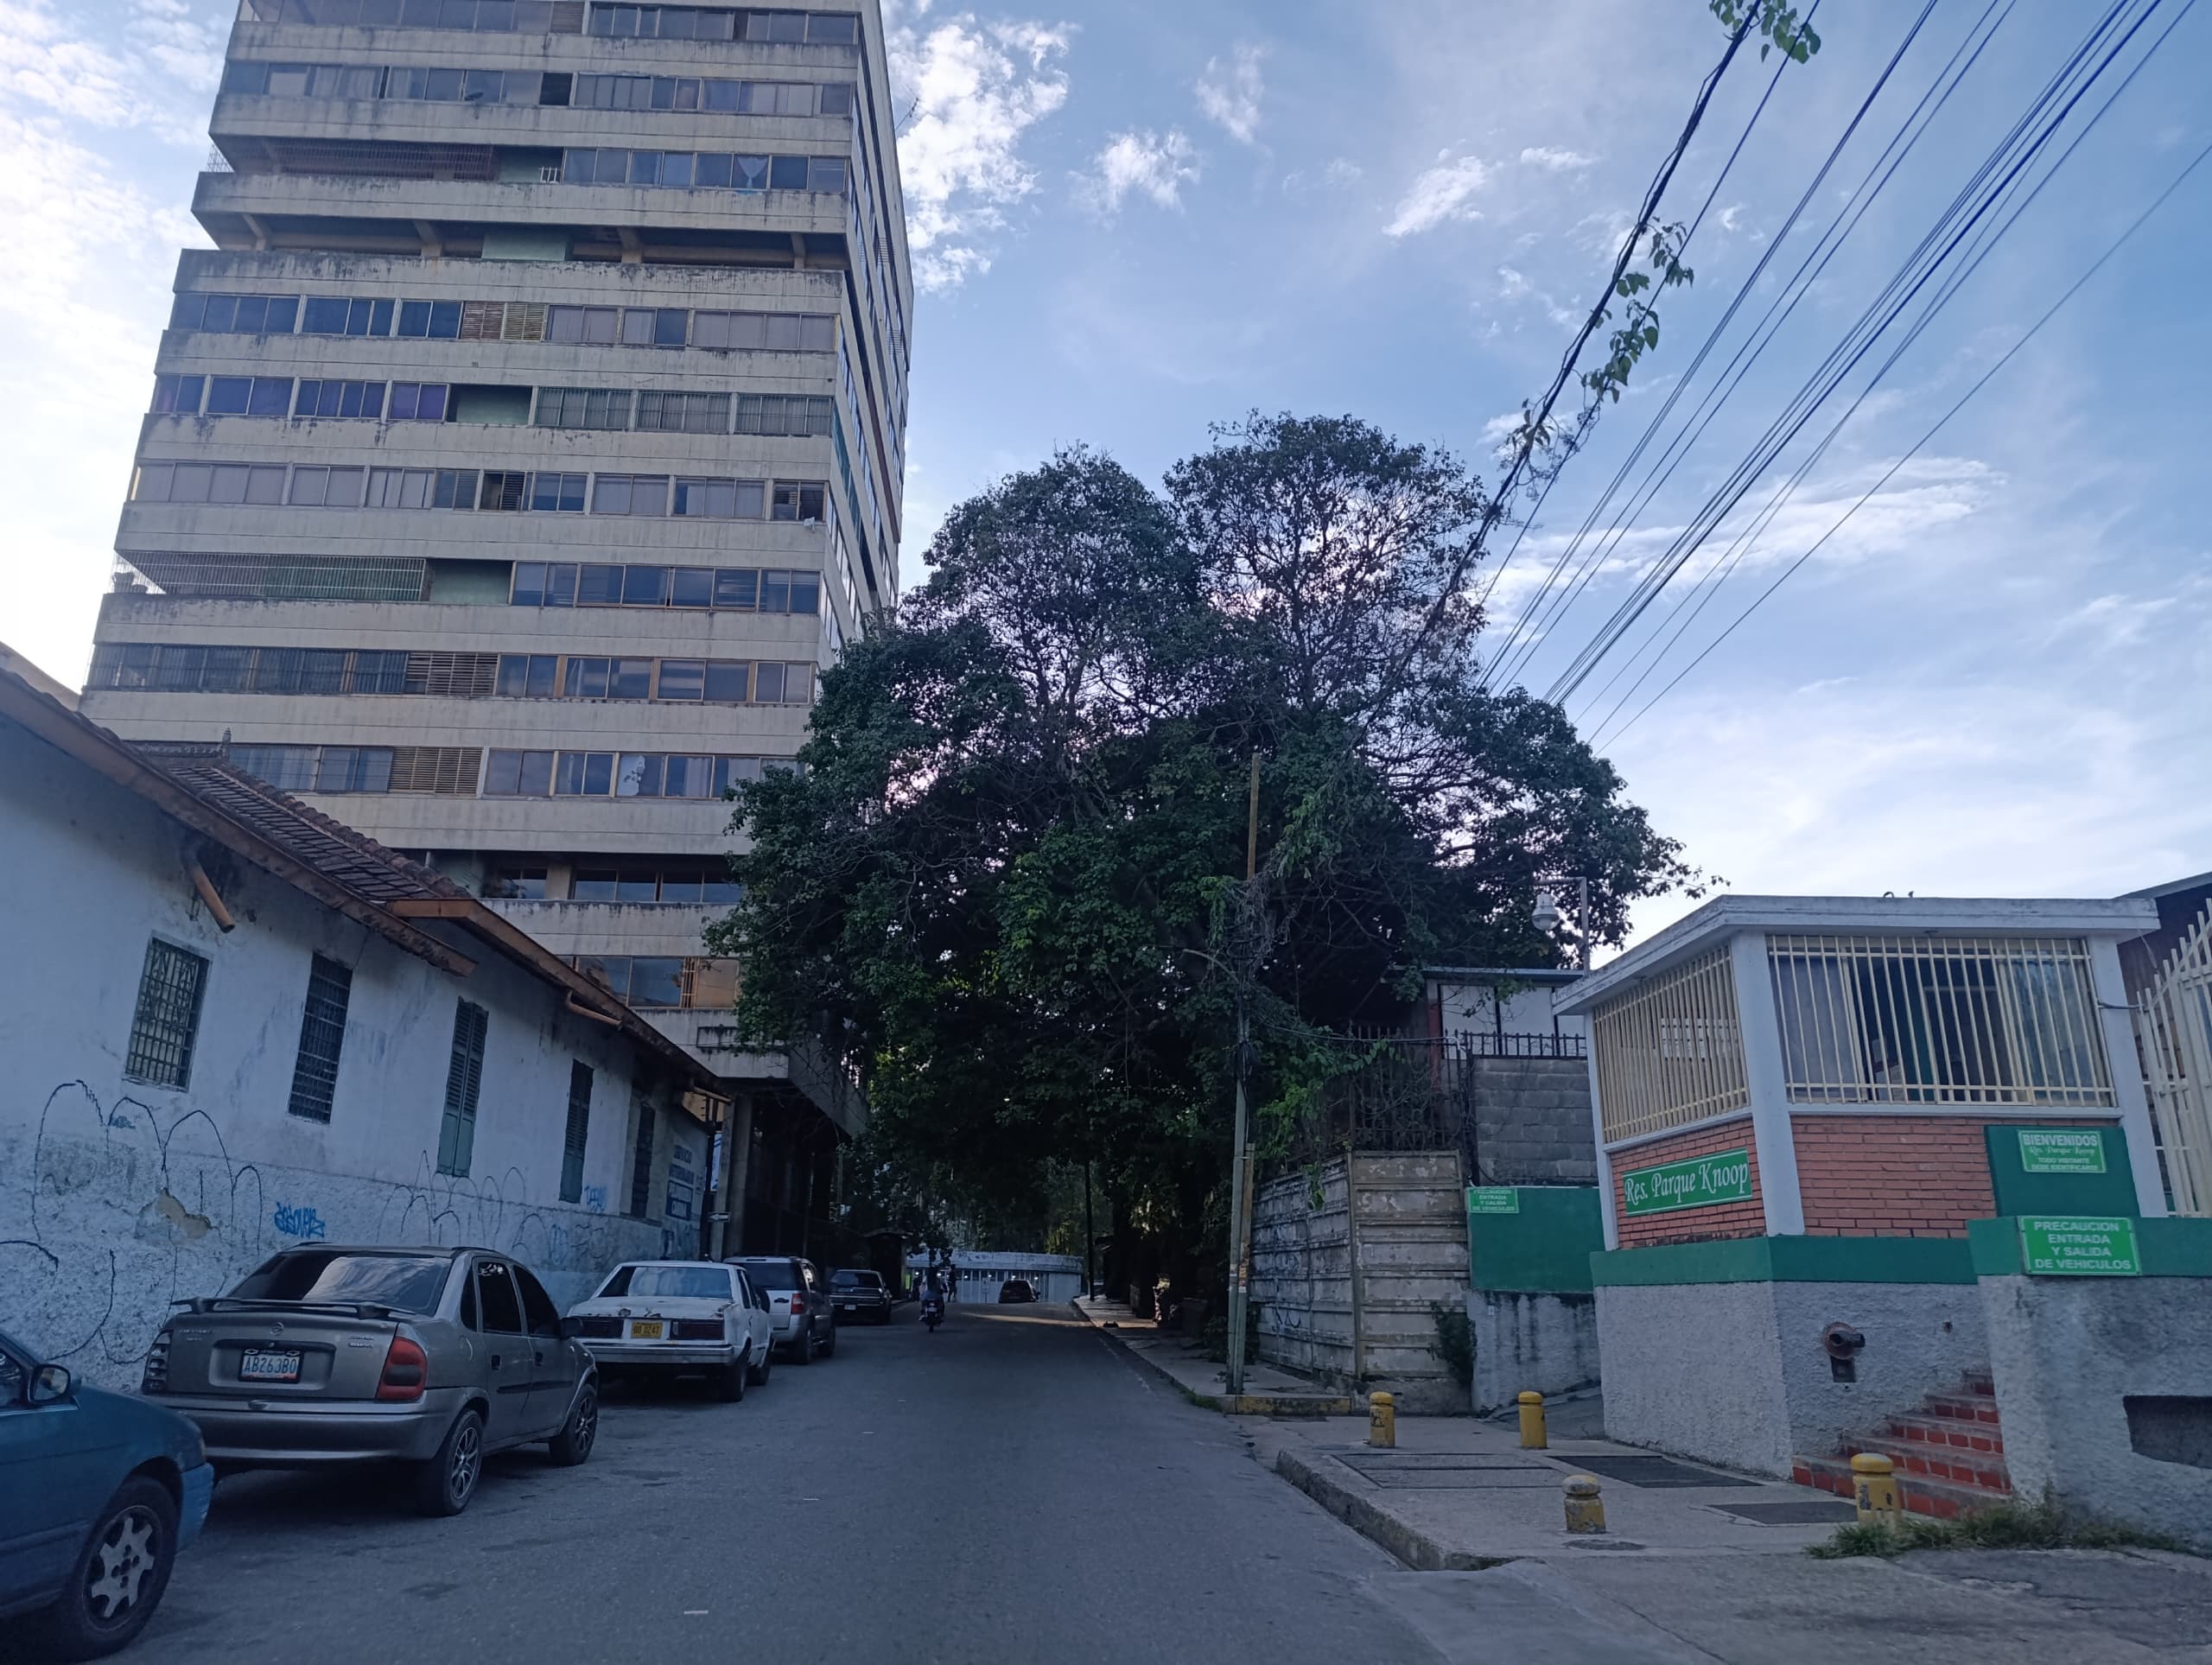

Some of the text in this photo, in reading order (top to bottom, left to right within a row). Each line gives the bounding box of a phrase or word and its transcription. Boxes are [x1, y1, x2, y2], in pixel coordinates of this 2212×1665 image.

[2022, 1134, 2098, 1146] BIENVENIDOS
[1624, 1162, 1748, 1205] Res. Parque Knoop
[2033, 1221, 2120, 1231] PRECAUCION
[2048, 1234, 2111, 1243] ENTRADA
[2051, 1246, 2112, 1256] Y SALIDA
[2035, 1259, 2131, 1269] DE VEHICULOS
